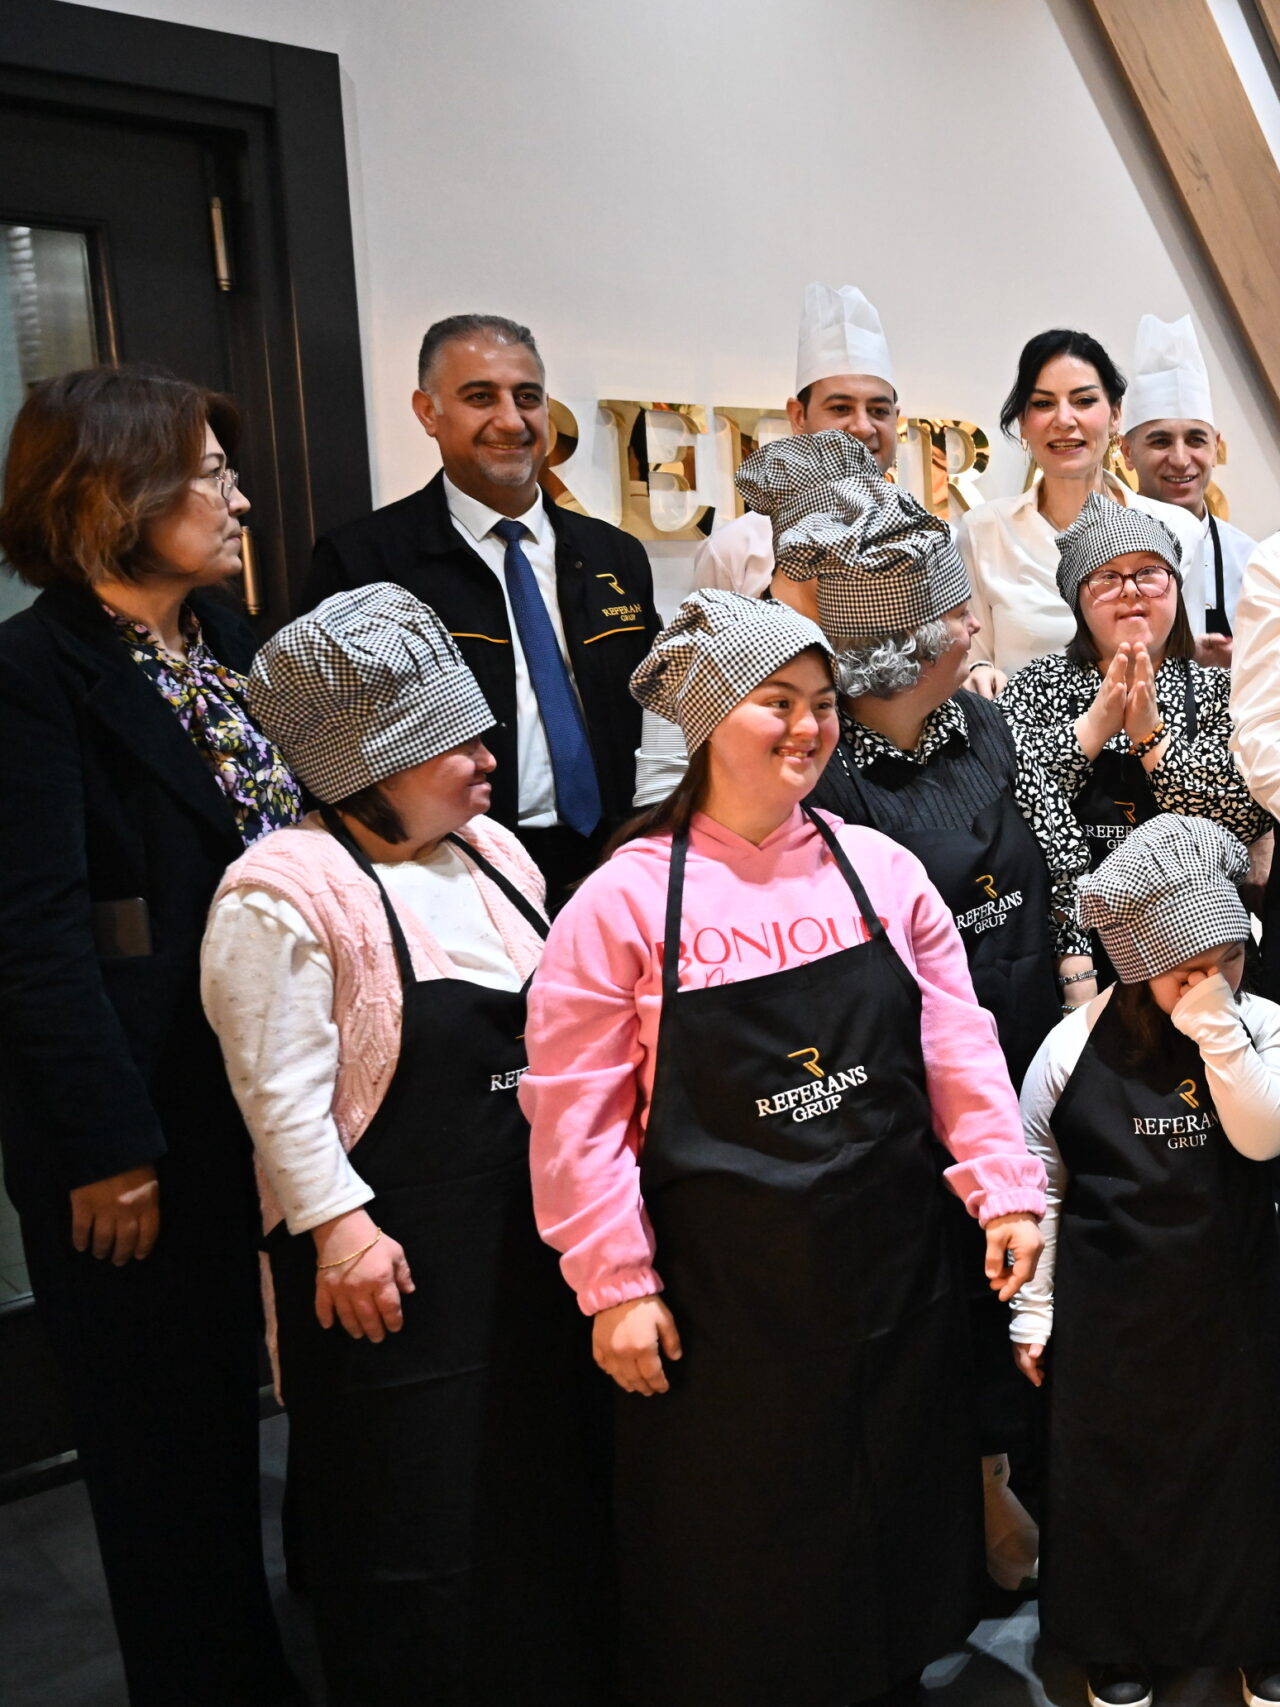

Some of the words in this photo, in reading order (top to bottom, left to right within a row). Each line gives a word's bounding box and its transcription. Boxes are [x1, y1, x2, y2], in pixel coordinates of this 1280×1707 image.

[956, 890, 1023, 930] REFERANS
[974, 913, 1007, 934] GRUP
[755, 1065, 868, 1117] REFERANS
[792, 1094, 842, 1122] GRUP
[1167, 1134, 1207, 1150] GRUP
